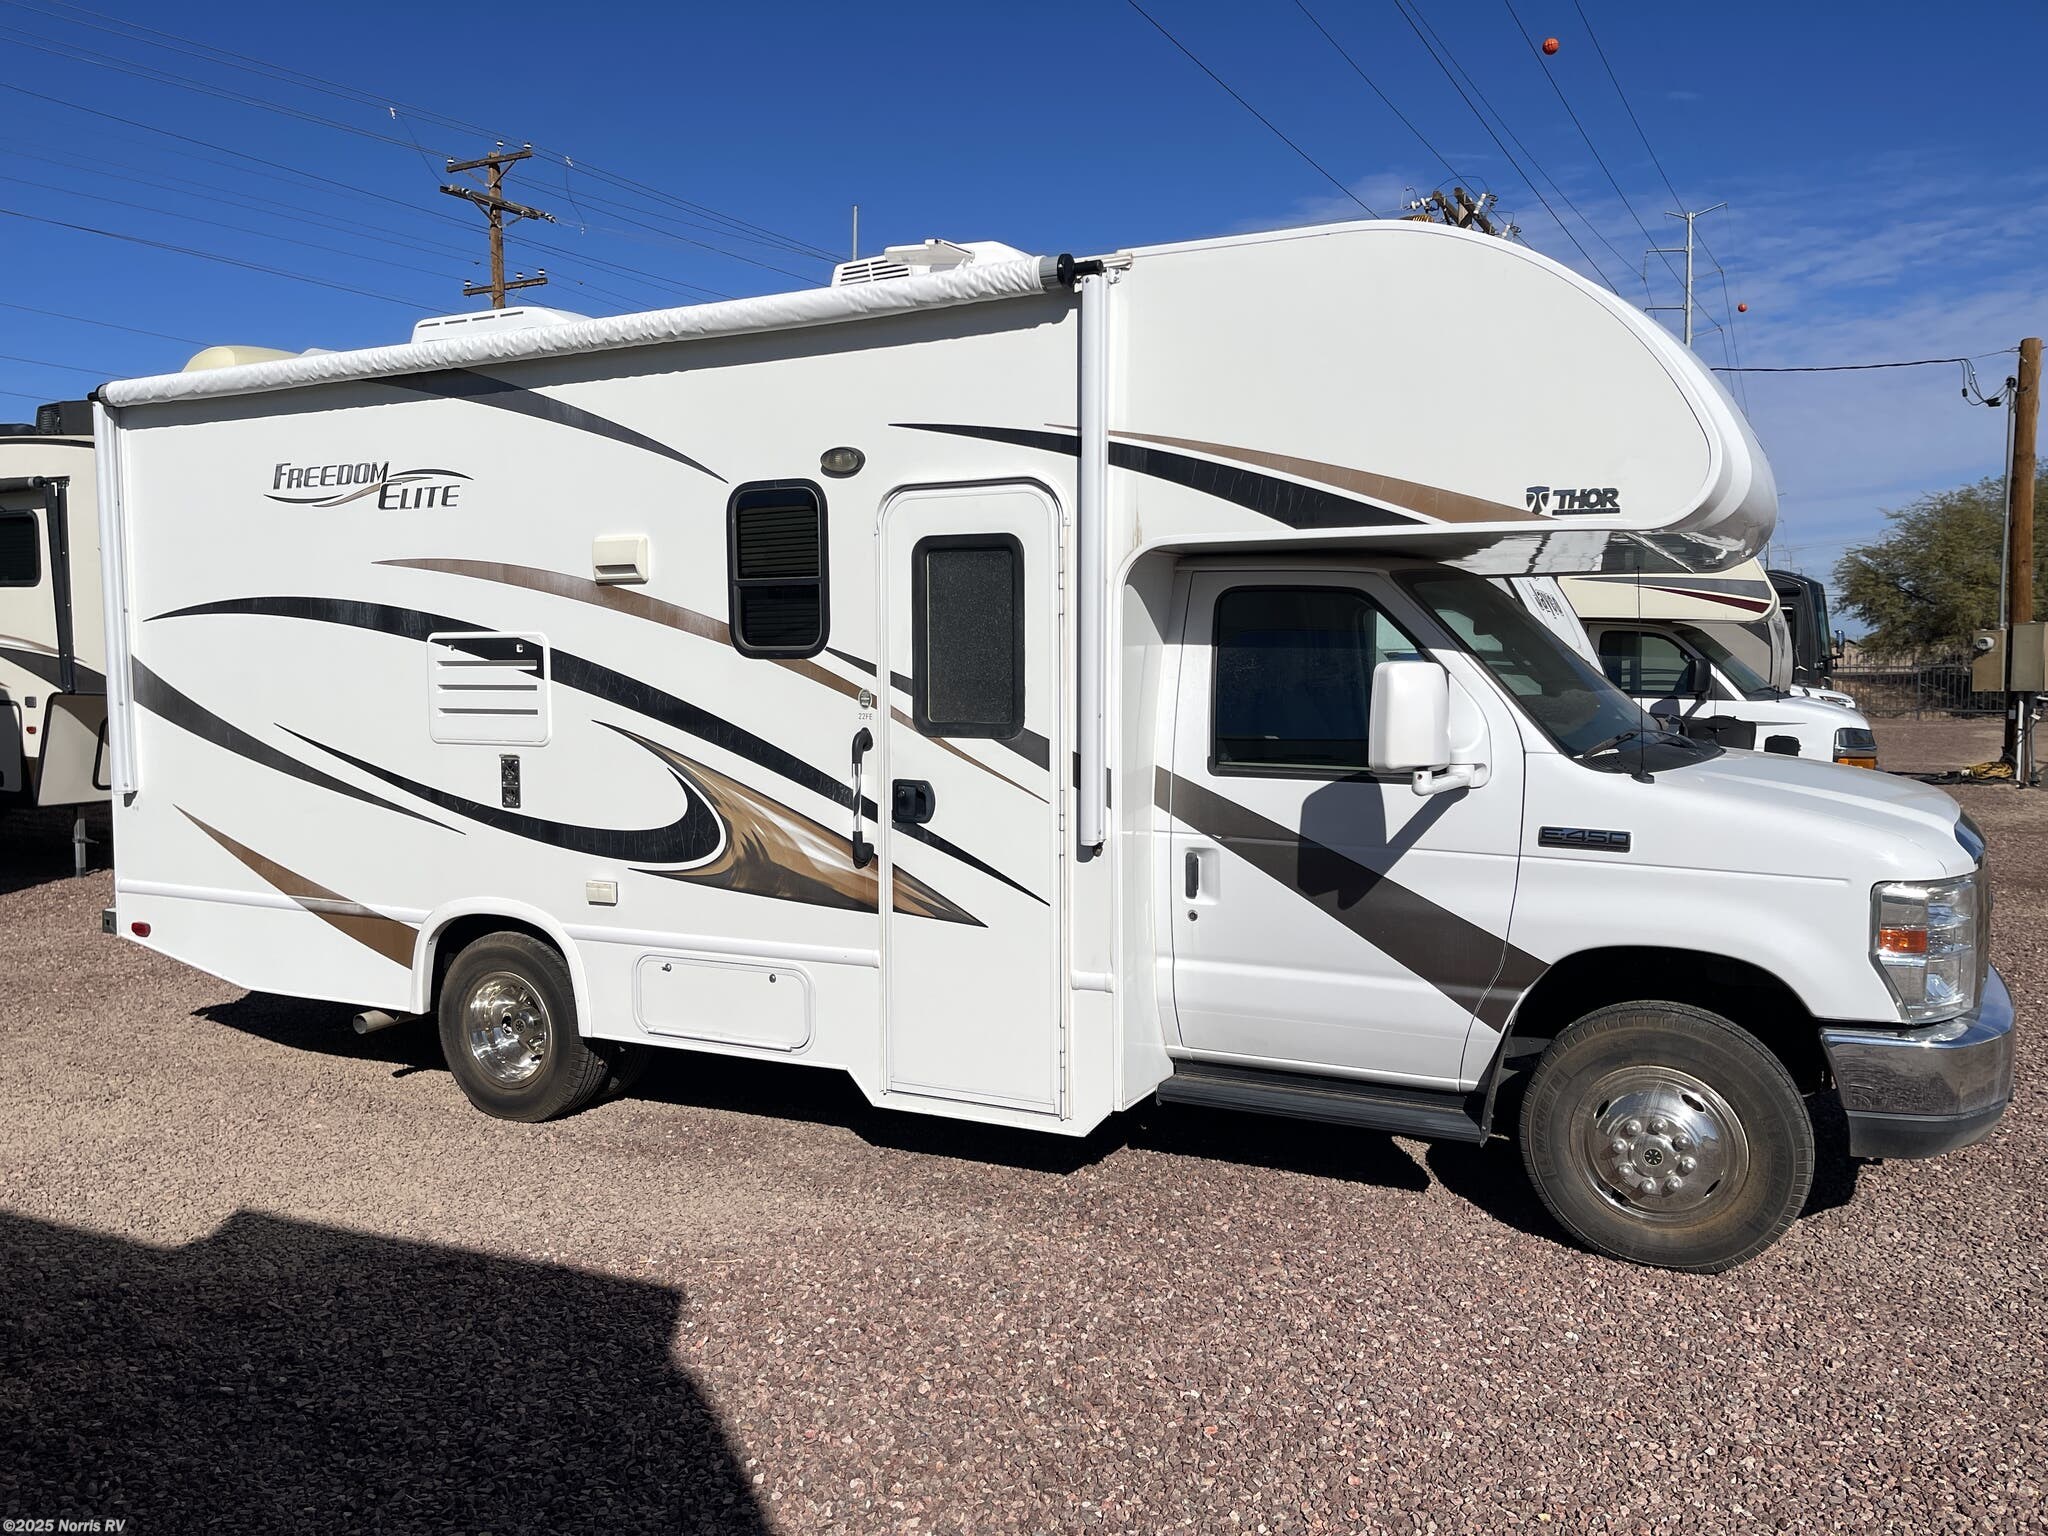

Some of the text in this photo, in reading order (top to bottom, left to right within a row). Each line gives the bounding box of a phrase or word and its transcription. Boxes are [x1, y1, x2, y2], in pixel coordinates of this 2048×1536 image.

[273, 461, 389, 490] FREEDOM
[378, 482, 460, 510] ELITE
[1552, 487, 1620, 509] THOR
